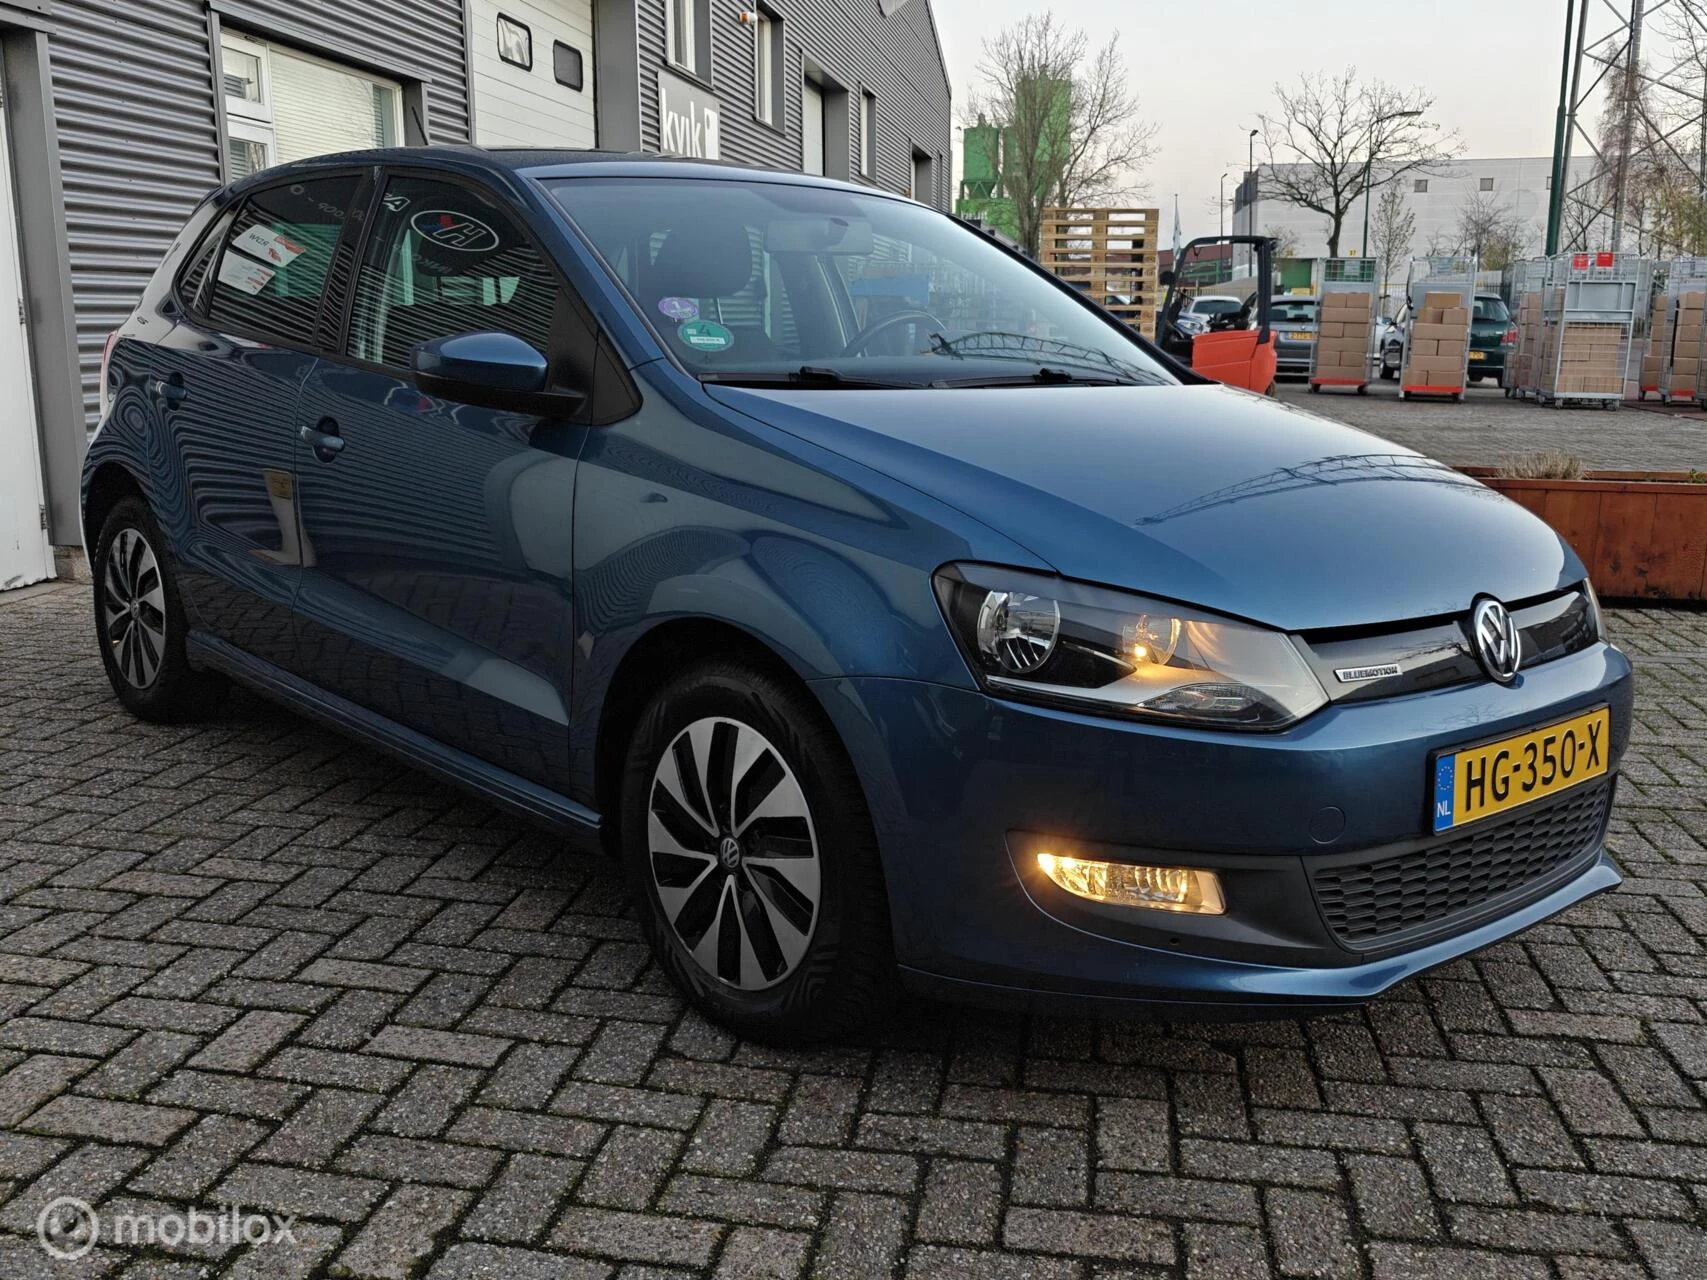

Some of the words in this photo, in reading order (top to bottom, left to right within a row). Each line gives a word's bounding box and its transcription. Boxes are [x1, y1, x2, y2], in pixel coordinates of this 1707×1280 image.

[661, 87, 702, 158] kvik
[1342, 666, 1399, 680] BLUEMOTION
[1465, 719, 1602, 813] HG-350-X
[1437, 800, 1451, 818] NL
